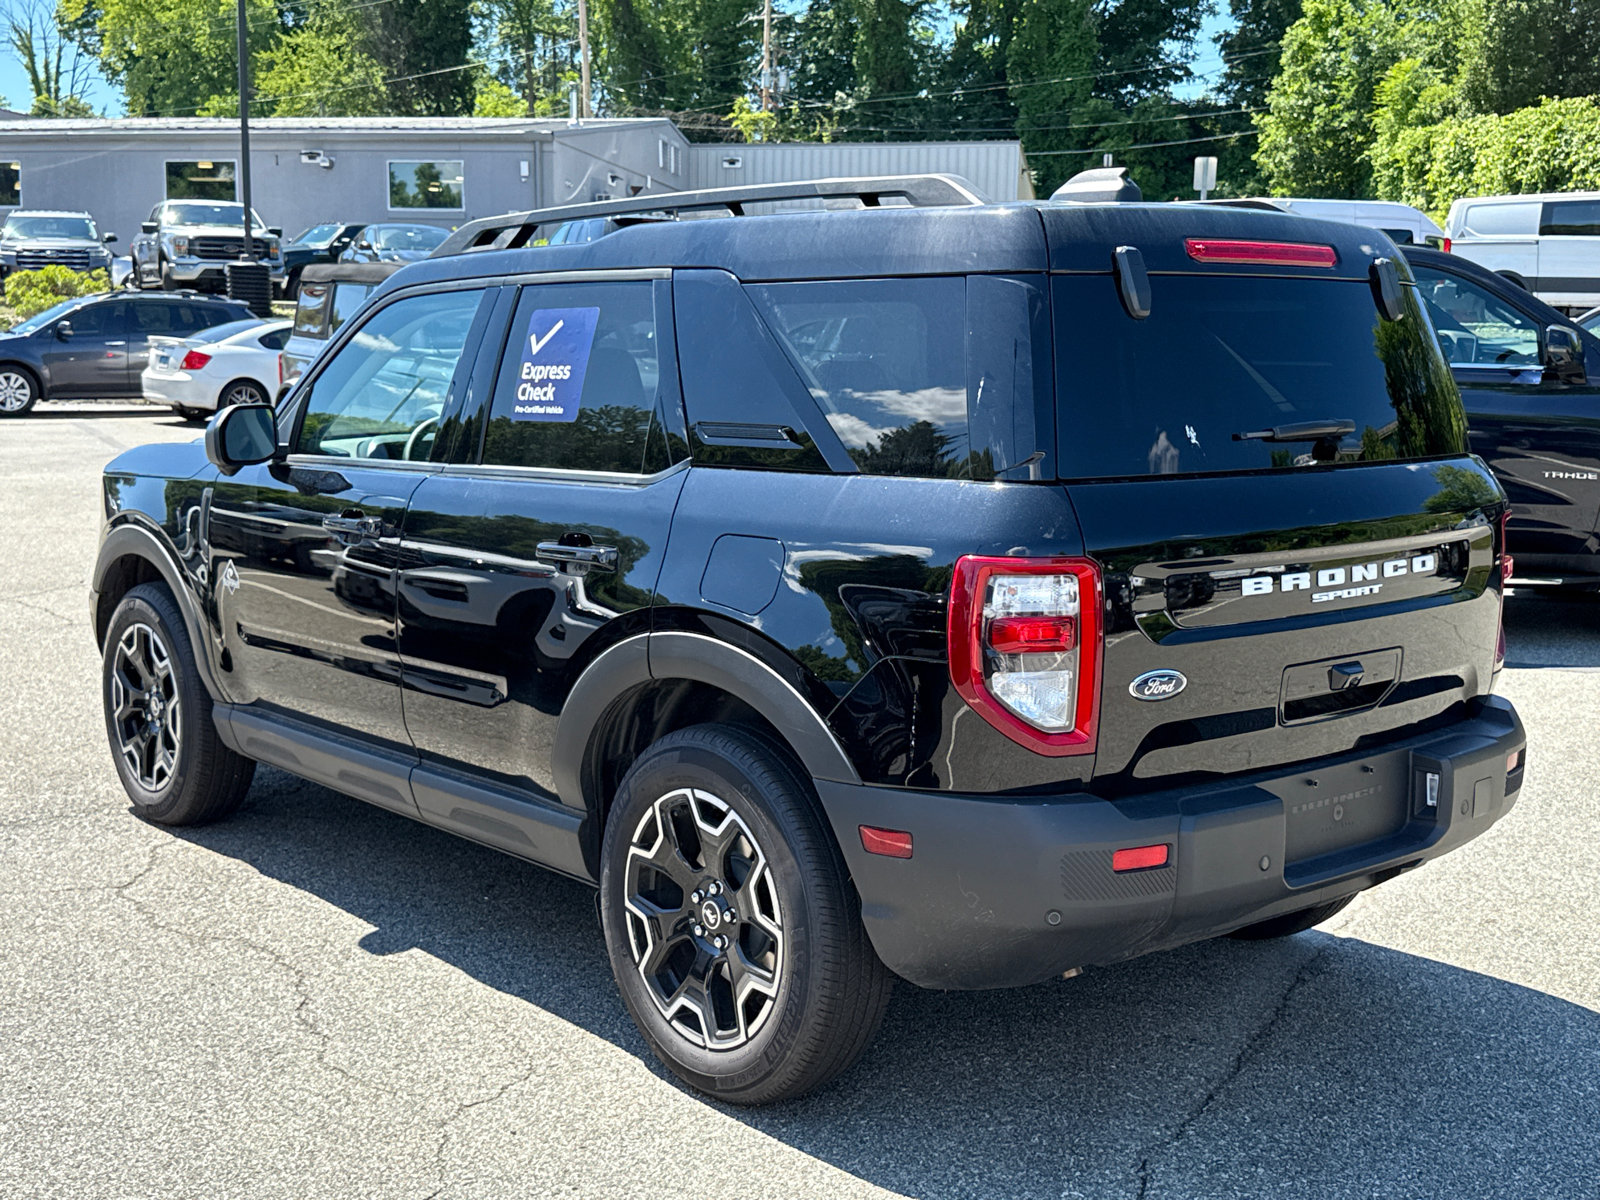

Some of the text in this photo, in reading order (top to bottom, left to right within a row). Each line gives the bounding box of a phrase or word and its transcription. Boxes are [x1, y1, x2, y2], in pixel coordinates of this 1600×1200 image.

[521, 361, 572, 383] Express
[517, 382, 556, 401] Check
[514, 405, 564, 415] Pre-Certified Vehicle
[1541, 471, 1598, 480] TAHOE
[1241, 554, 1435, 596] BRONCO
[1311, 583, 1383, 603] SPORT
[1144, 676, 1178, 695] Ford
